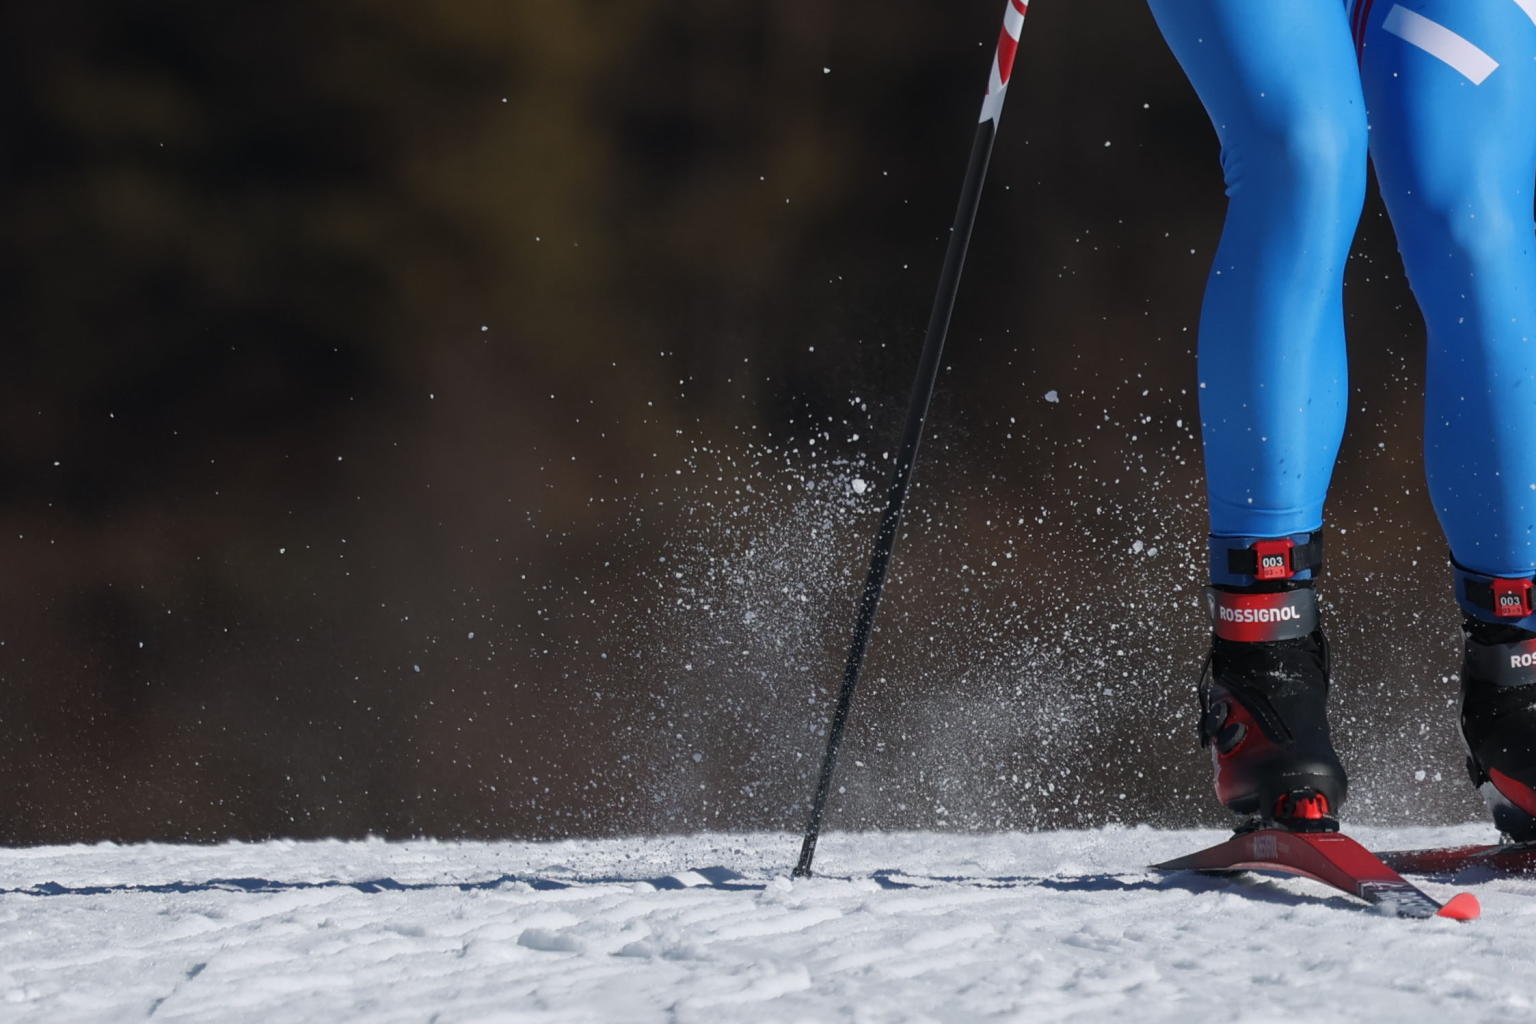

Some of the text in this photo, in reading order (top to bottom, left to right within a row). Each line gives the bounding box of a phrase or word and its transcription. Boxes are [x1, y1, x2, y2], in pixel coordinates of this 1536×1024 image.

[1262, 556, 1284, 568] 003
[1500, 596, 1521, 606] 003
[1219, 605, 1301, 623] ROSSIGNOL
